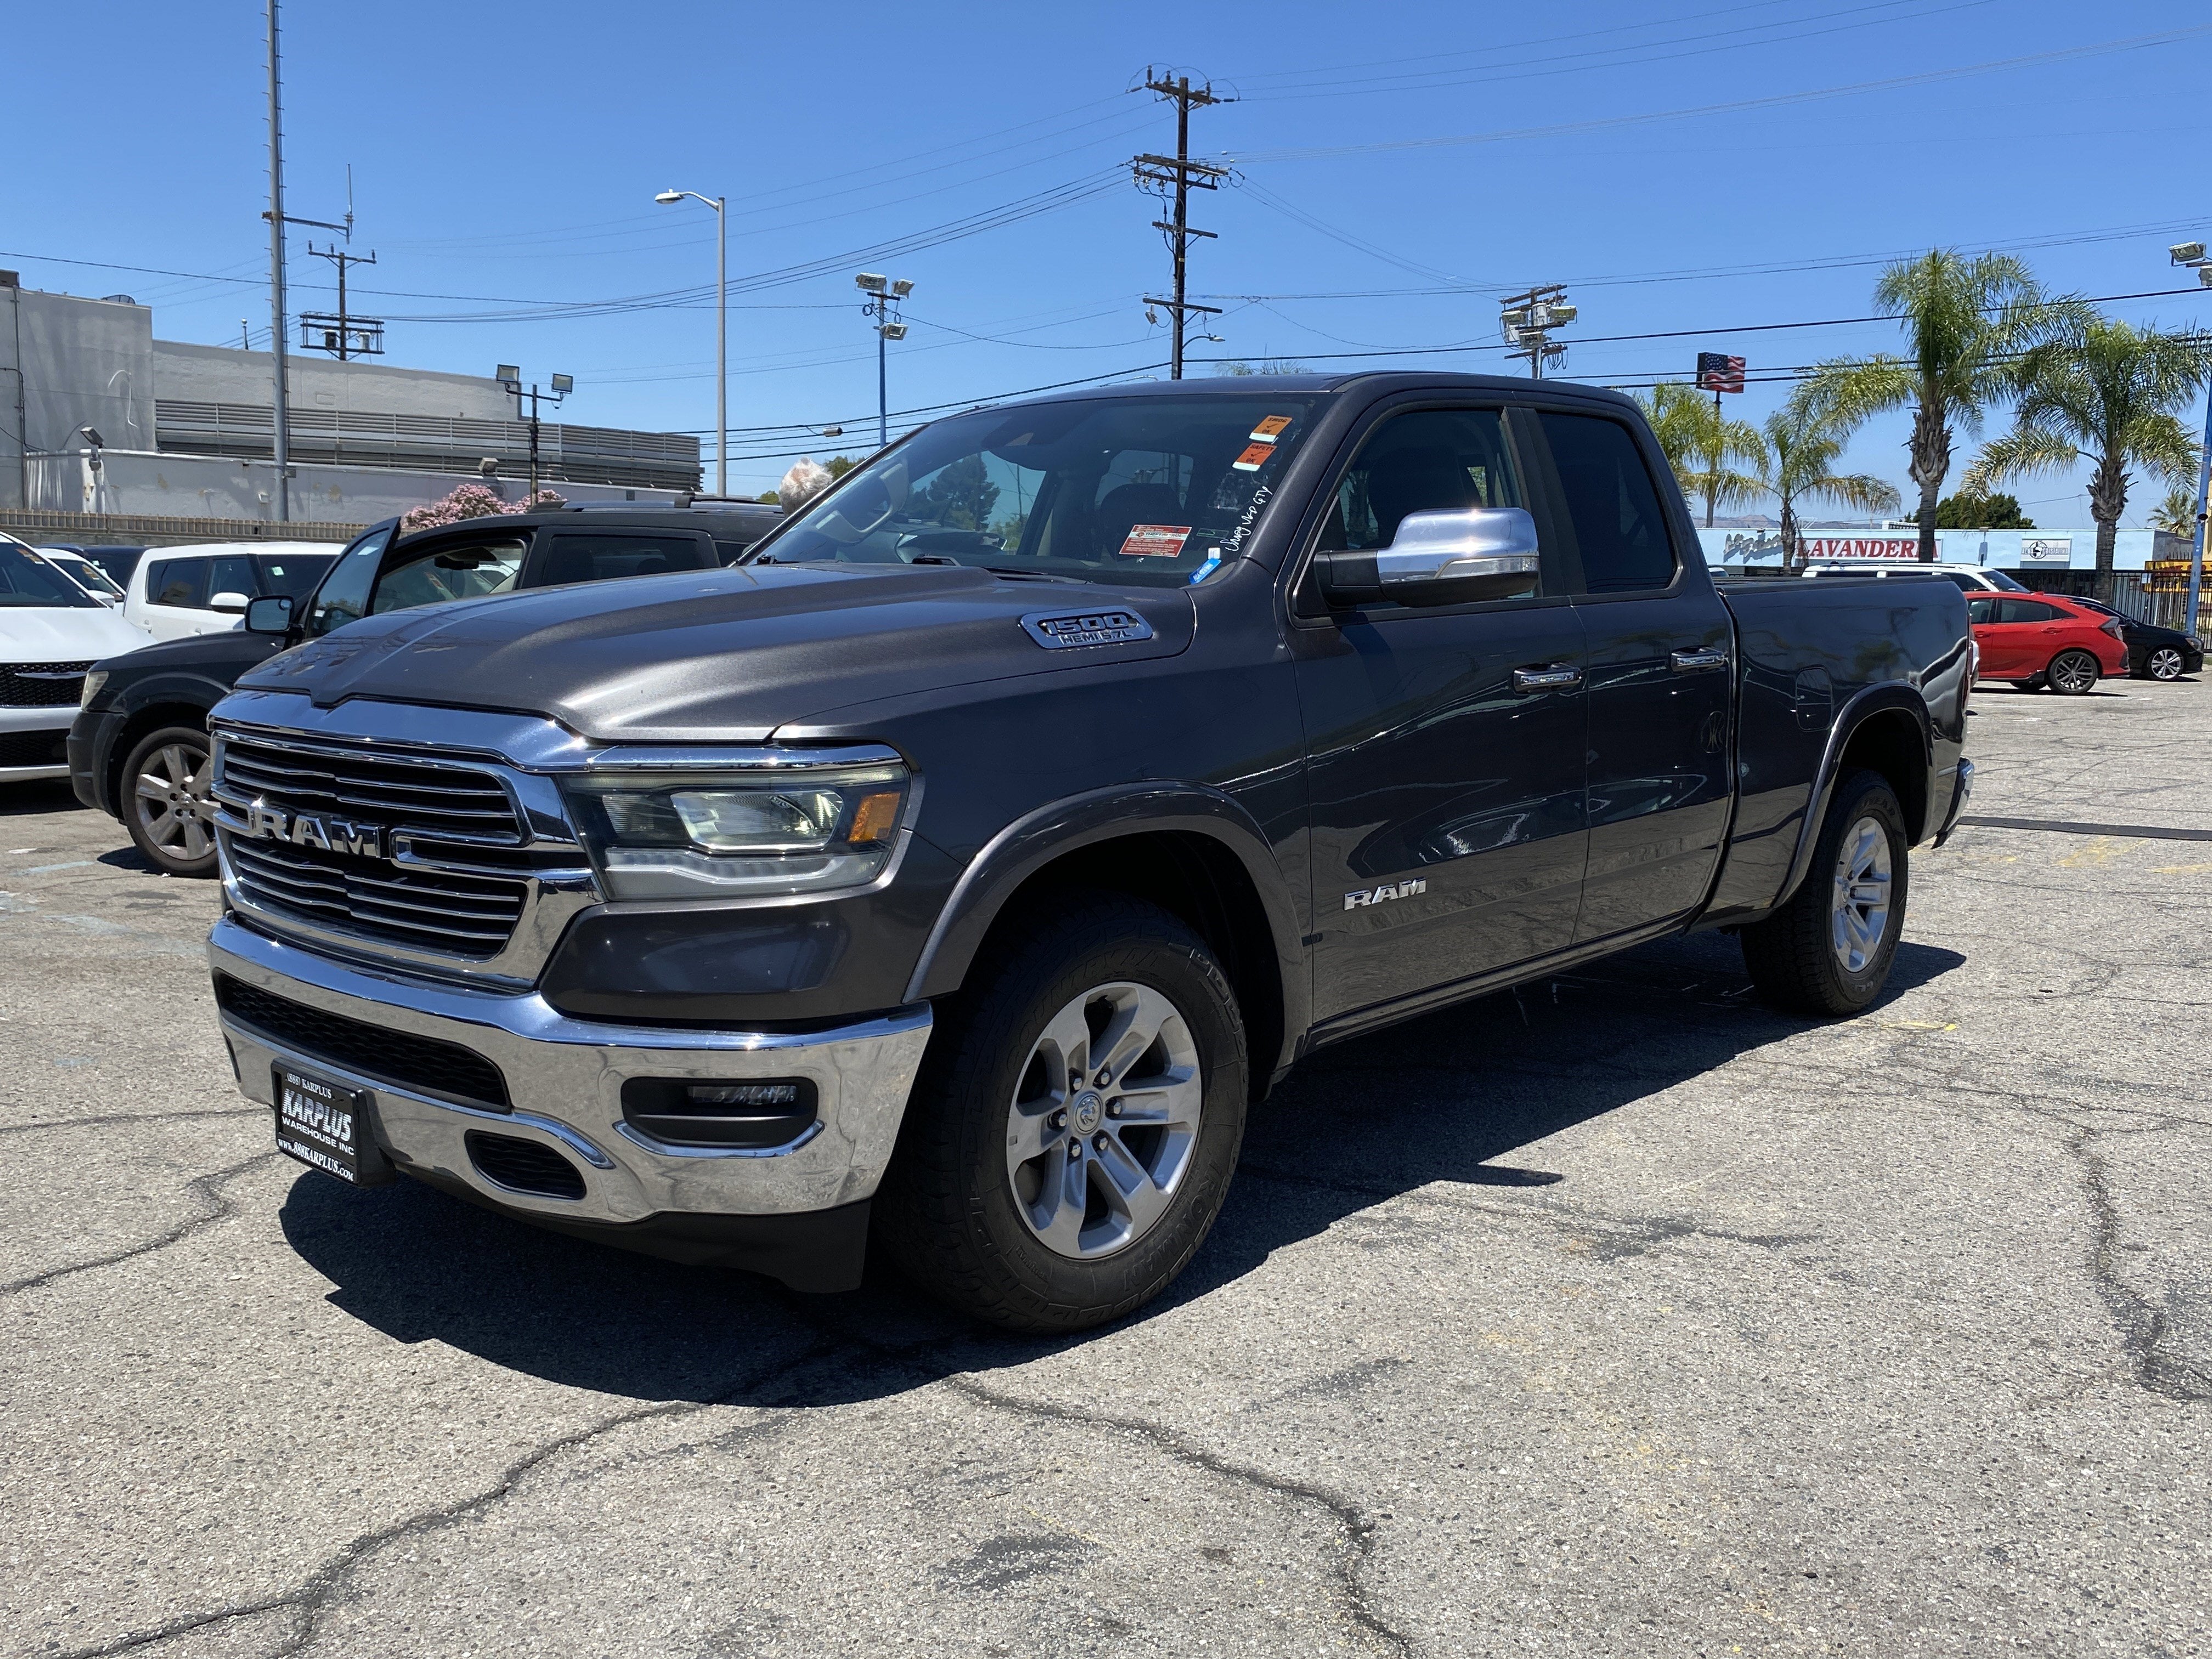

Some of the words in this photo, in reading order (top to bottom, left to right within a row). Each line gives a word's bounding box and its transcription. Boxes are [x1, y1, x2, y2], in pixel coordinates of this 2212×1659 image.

[1041, 614, 1129, 635] 1500
[1058, 632, 1100, 645] HEMI
[1101, 629, 1133, 642] 5.7L
[251, 803, 386, 859] RAM
[1344, 877, 1426, 911] RAM
[286, 1072, 301, 1086] (888)
[301, 1078, 332, 1099] KARPLUS
[281, 1087, 352, 1142] KARPLUS
[281, 1115, 337, 1148] WAREHOUSE
[339, 1142, 354, 1156] INC
